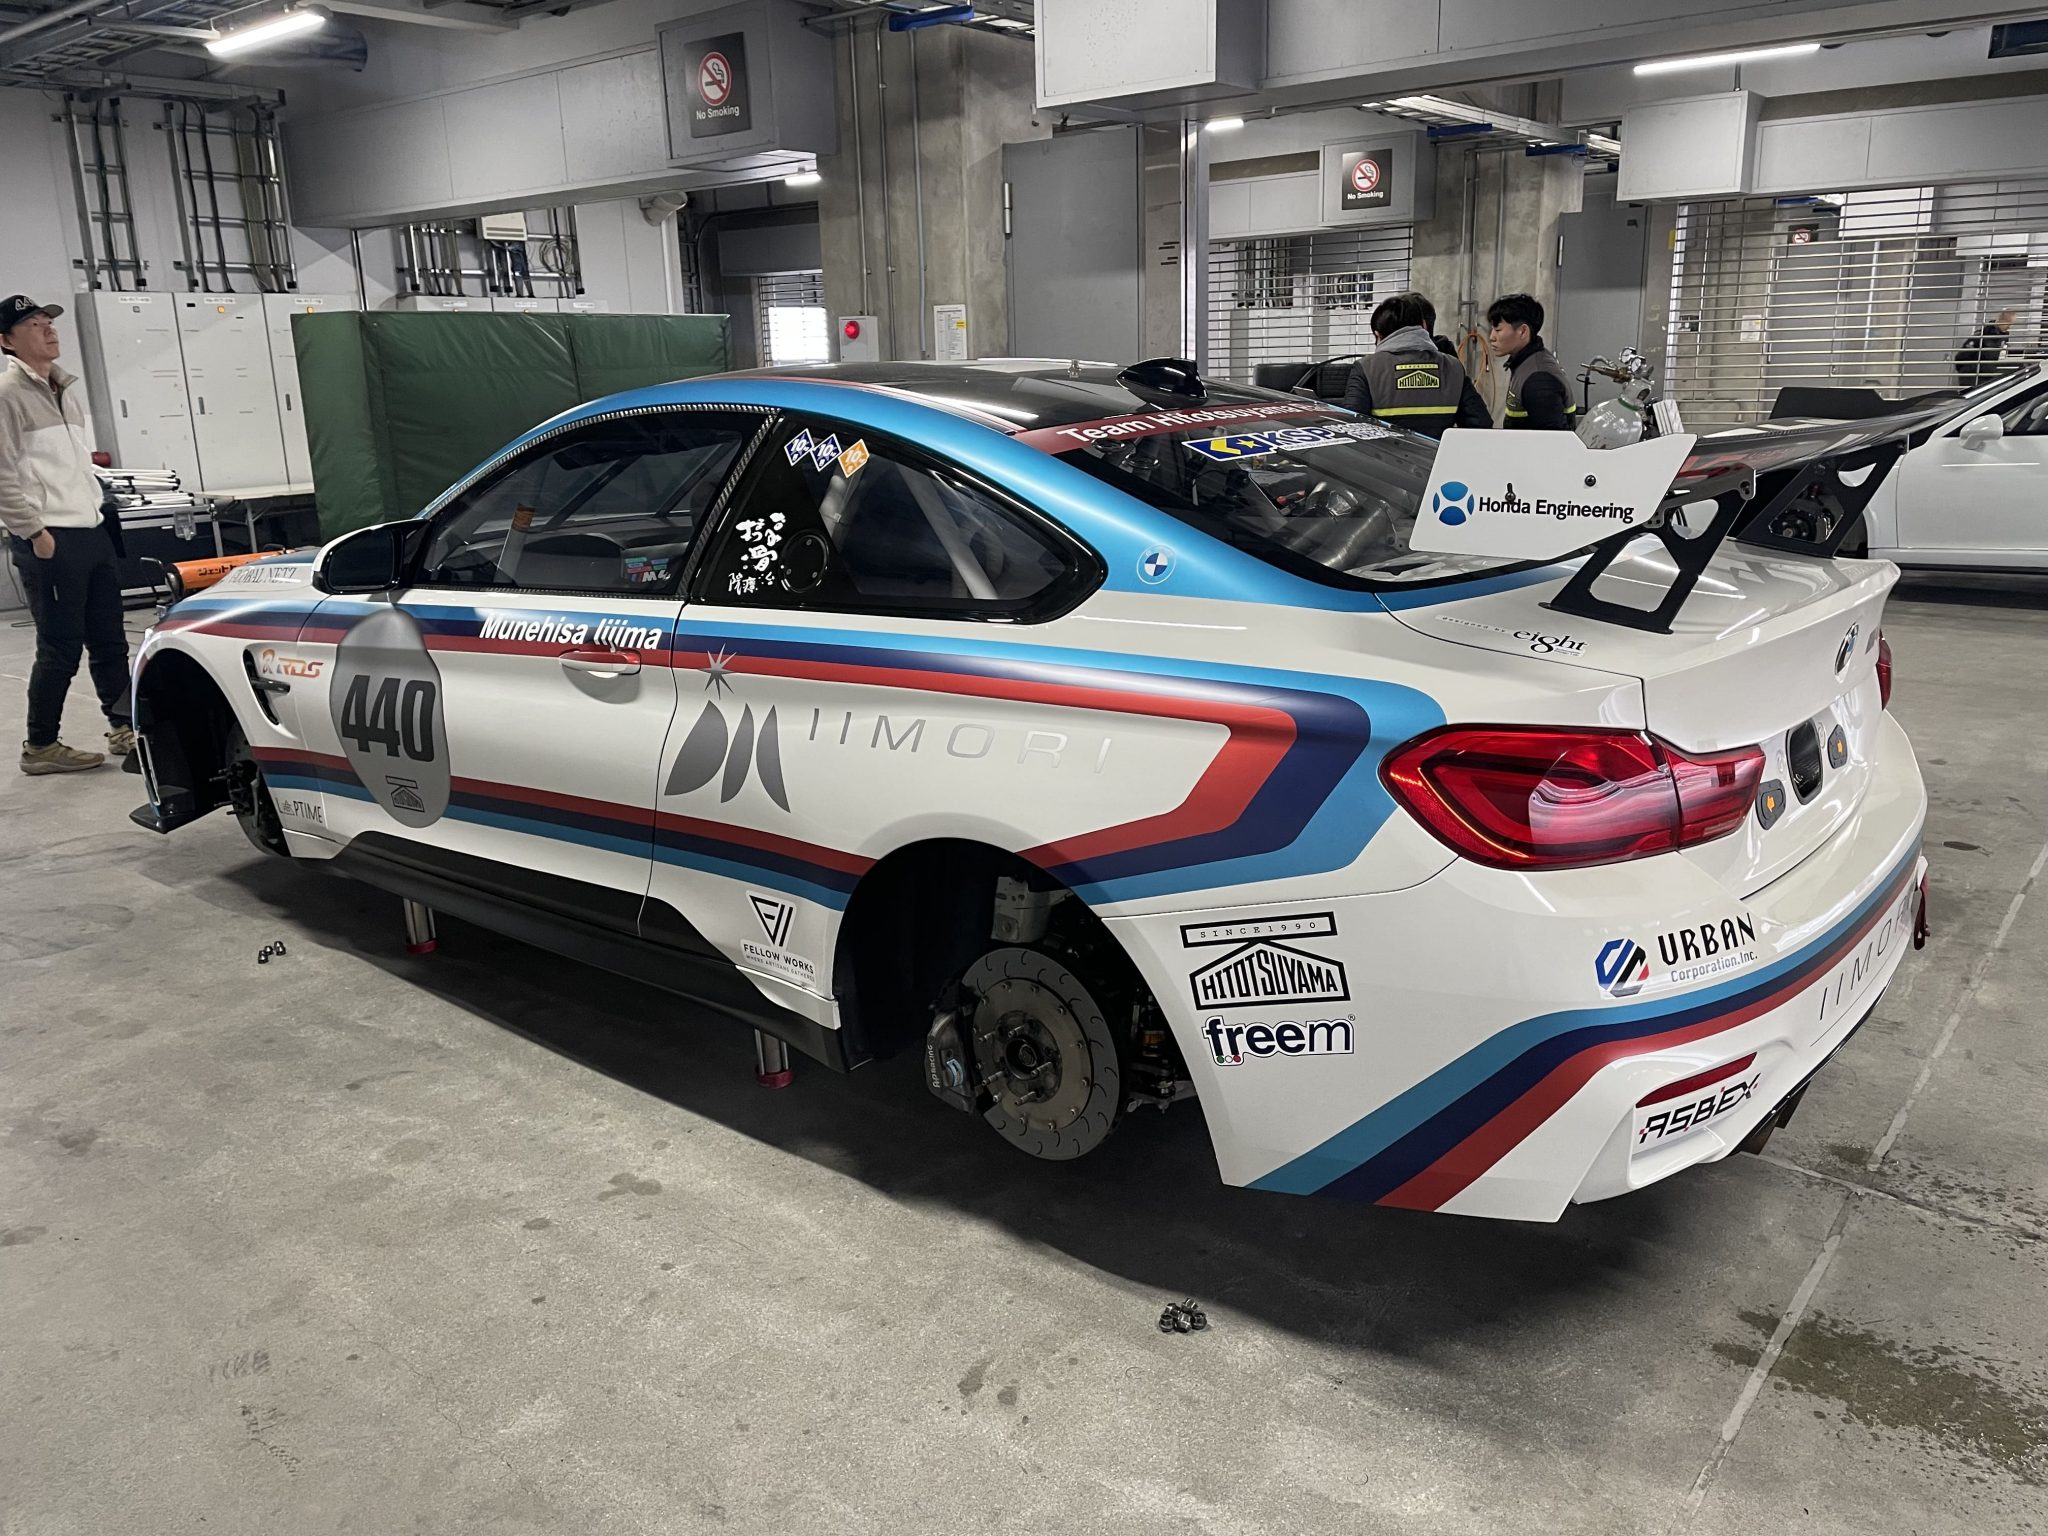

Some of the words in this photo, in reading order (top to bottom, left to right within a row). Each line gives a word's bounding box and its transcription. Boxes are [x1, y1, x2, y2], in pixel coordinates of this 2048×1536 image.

[696, 110, 706, 120] No
[707, 106, 740, 118] Smoking
[1357, 191, 1384, 199] Smoking
[1056, 420, 1156, 443] Team
[1146, 403, 1304, 427] Hitotsuyama
[1252, 427, 1333, 447] KSP
[1479, 497, 1530, 514] Honda
[1535, 500, 1634, 524] Engineering
[480, 614, 588, 645] Munehisa
[593, 618, 662, 653] Iijima
[341, 675, 436, 762] 440
[809, 708, 1111, 774] IIMORI
[743, 943, 780, 961] FELLOW
[783, 955, 814, 974] WORKS
[1657, 912, 1756, 966] URBAN
[1201, 949, 1338, 1000] HITOTSUYAMA
[1206, 1018, 1350, 1056] freem
[1639, 1072, 1761, 1144] ASBEX
